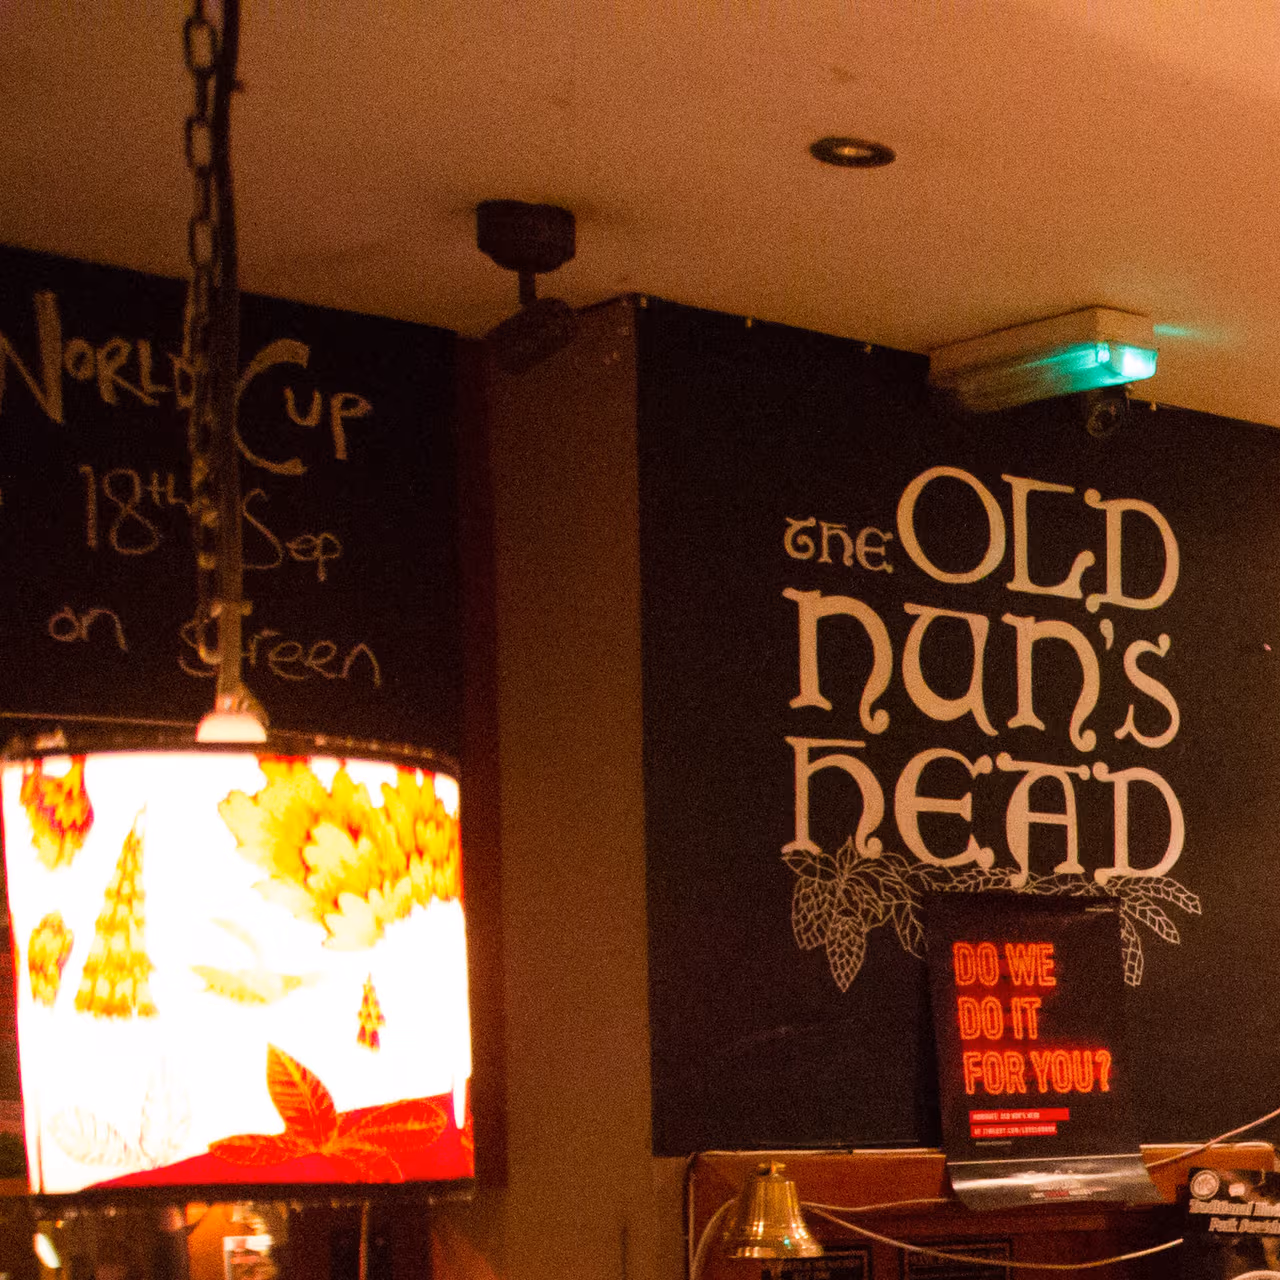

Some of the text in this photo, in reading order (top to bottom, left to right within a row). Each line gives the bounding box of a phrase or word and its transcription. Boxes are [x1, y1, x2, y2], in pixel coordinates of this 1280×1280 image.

[896, 464, 1181, 615] OLD
[48, 598, 382, 687] on Sreen
[782, 585, 1182, 753] NUN'S
[780, 734, 1187, 891] HEAD
[952, 941, 1058, 987] DO WE
[956, 995, 1043, 1041] DO IT
[962, 1049, 1113, 1096] FOR YOU?
